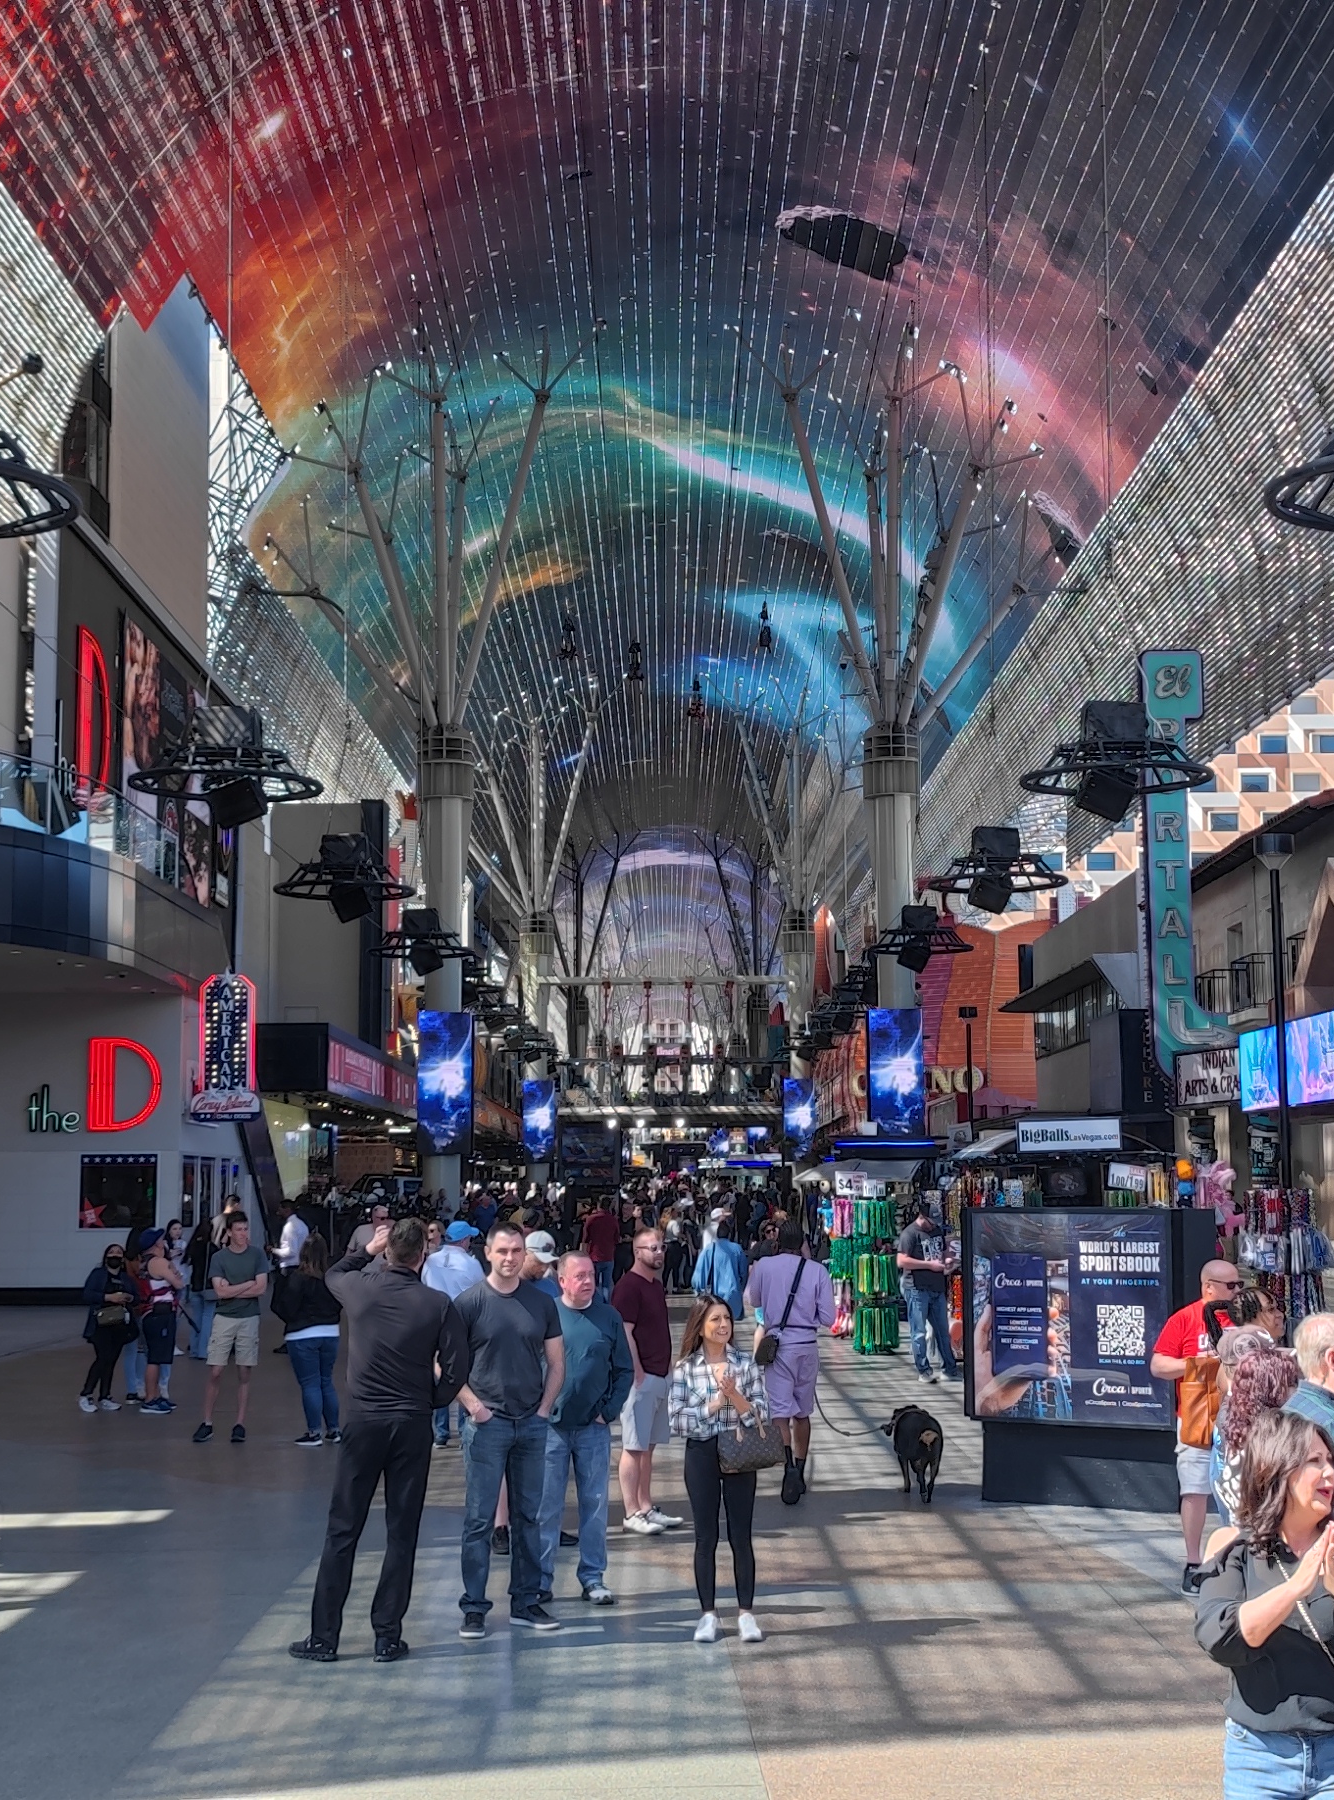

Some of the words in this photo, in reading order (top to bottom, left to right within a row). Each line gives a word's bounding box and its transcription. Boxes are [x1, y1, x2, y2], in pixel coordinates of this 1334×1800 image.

[1155, 665, 1190, 698] El
[75, 623, 111, 792] D
[219, 987, 234, 1088] AMERICAN
[1202, 1050, 1235, 1074] INDIAN
[28, 1084, 81, 1133] the
[88, 1037, 162, 1132] D
[1184, 1079, 1208, 1104] ARTS
[1211, 1080, 1219, 1093] &
[1079, 1241, 1119, 1253] WORLD'S
[1121, 1242, 1159, 1254] LARGEST
[1079, 1256, 1161, 1272] SPORTSBOOK
[994, 1272, 1023, 1290] Circa
[1025, 1279, 1043, 1287] SPORTS
[1115, 1278, 1160, 1286] FINGERTIPS
[1092, 1377, 1126, 1396] Circa
[1131, 1386, 1152, 1395] SPORTS
